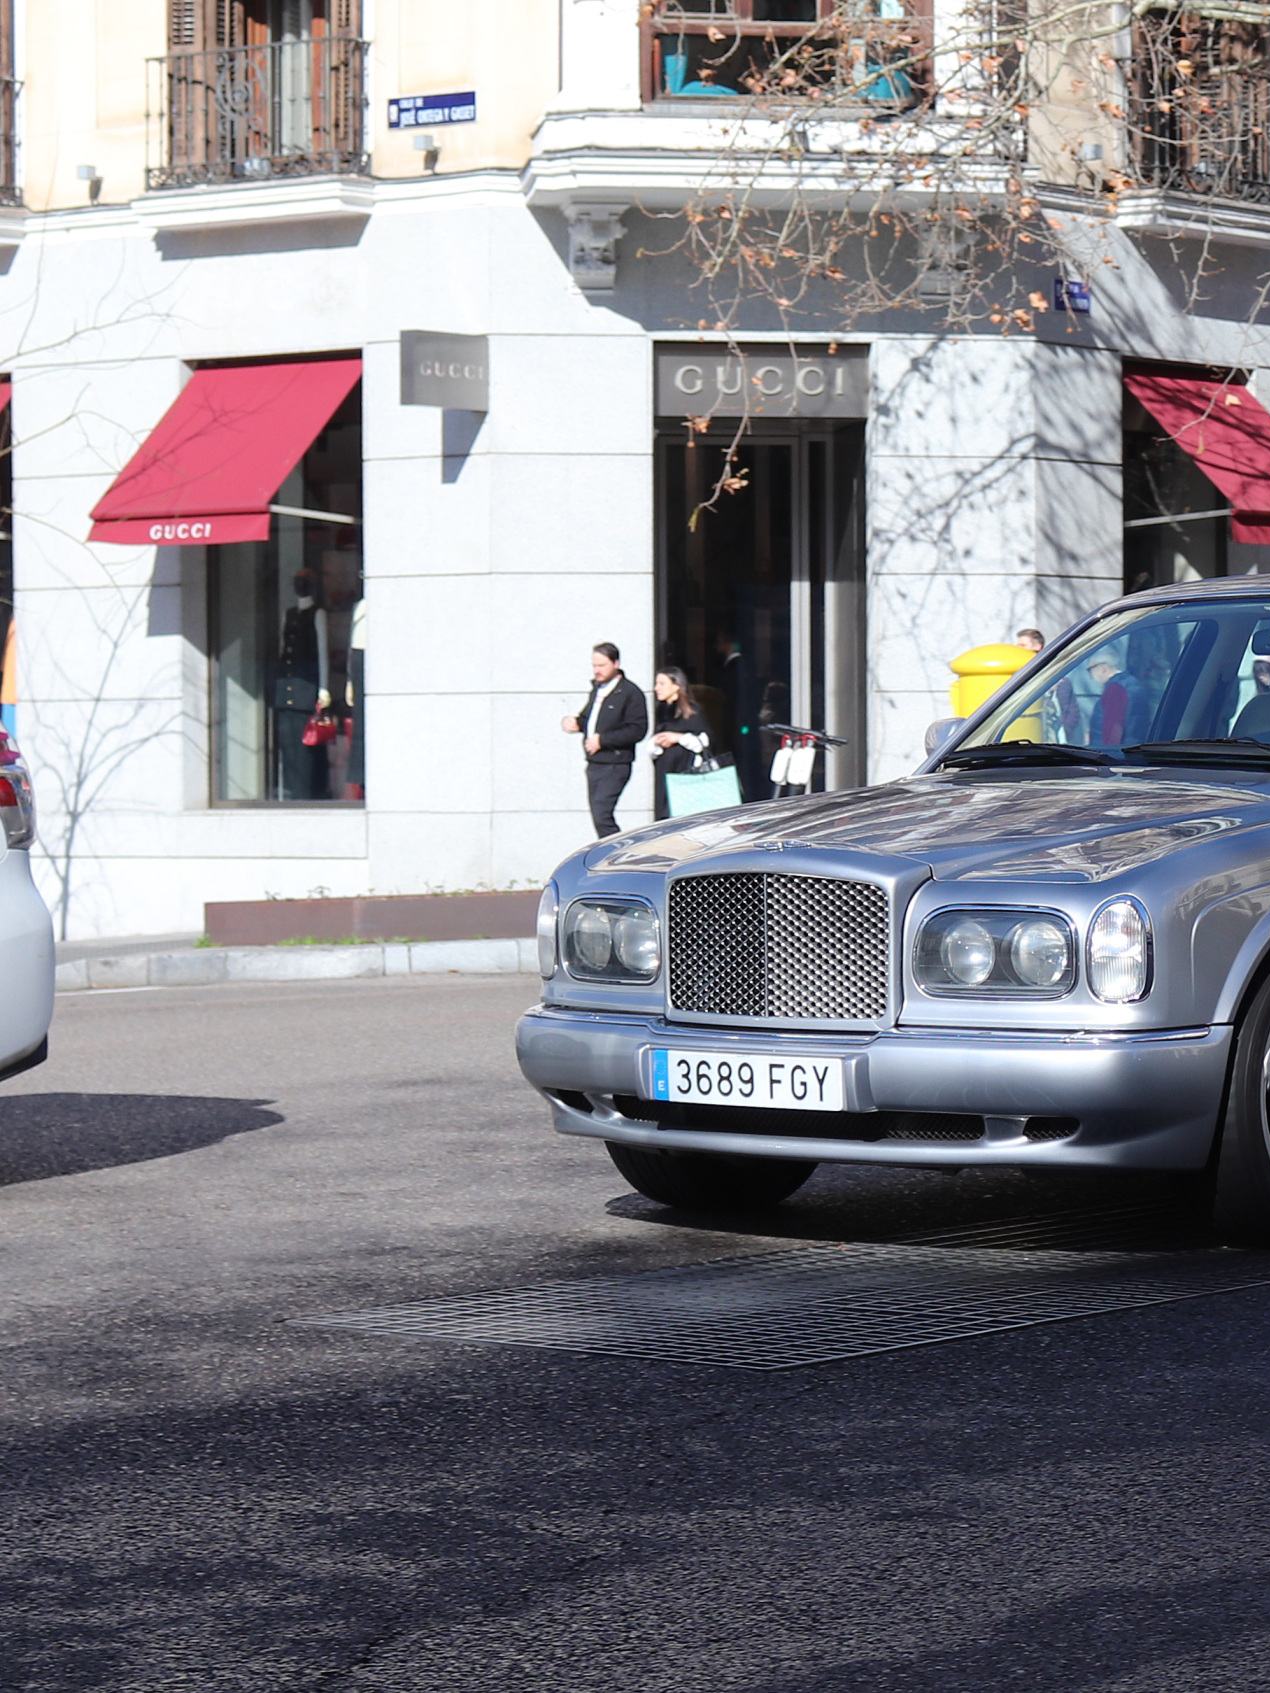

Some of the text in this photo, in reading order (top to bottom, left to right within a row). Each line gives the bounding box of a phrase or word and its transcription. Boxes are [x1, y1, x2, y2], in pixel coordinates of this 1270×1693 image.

[420, 361, 484, 380] GUCCI
[674, 364, 845, 396] GUCCI
[149, 522, 212, 541] GUCCI
[658, 1058, 829, 1102] E 3689 FGY
